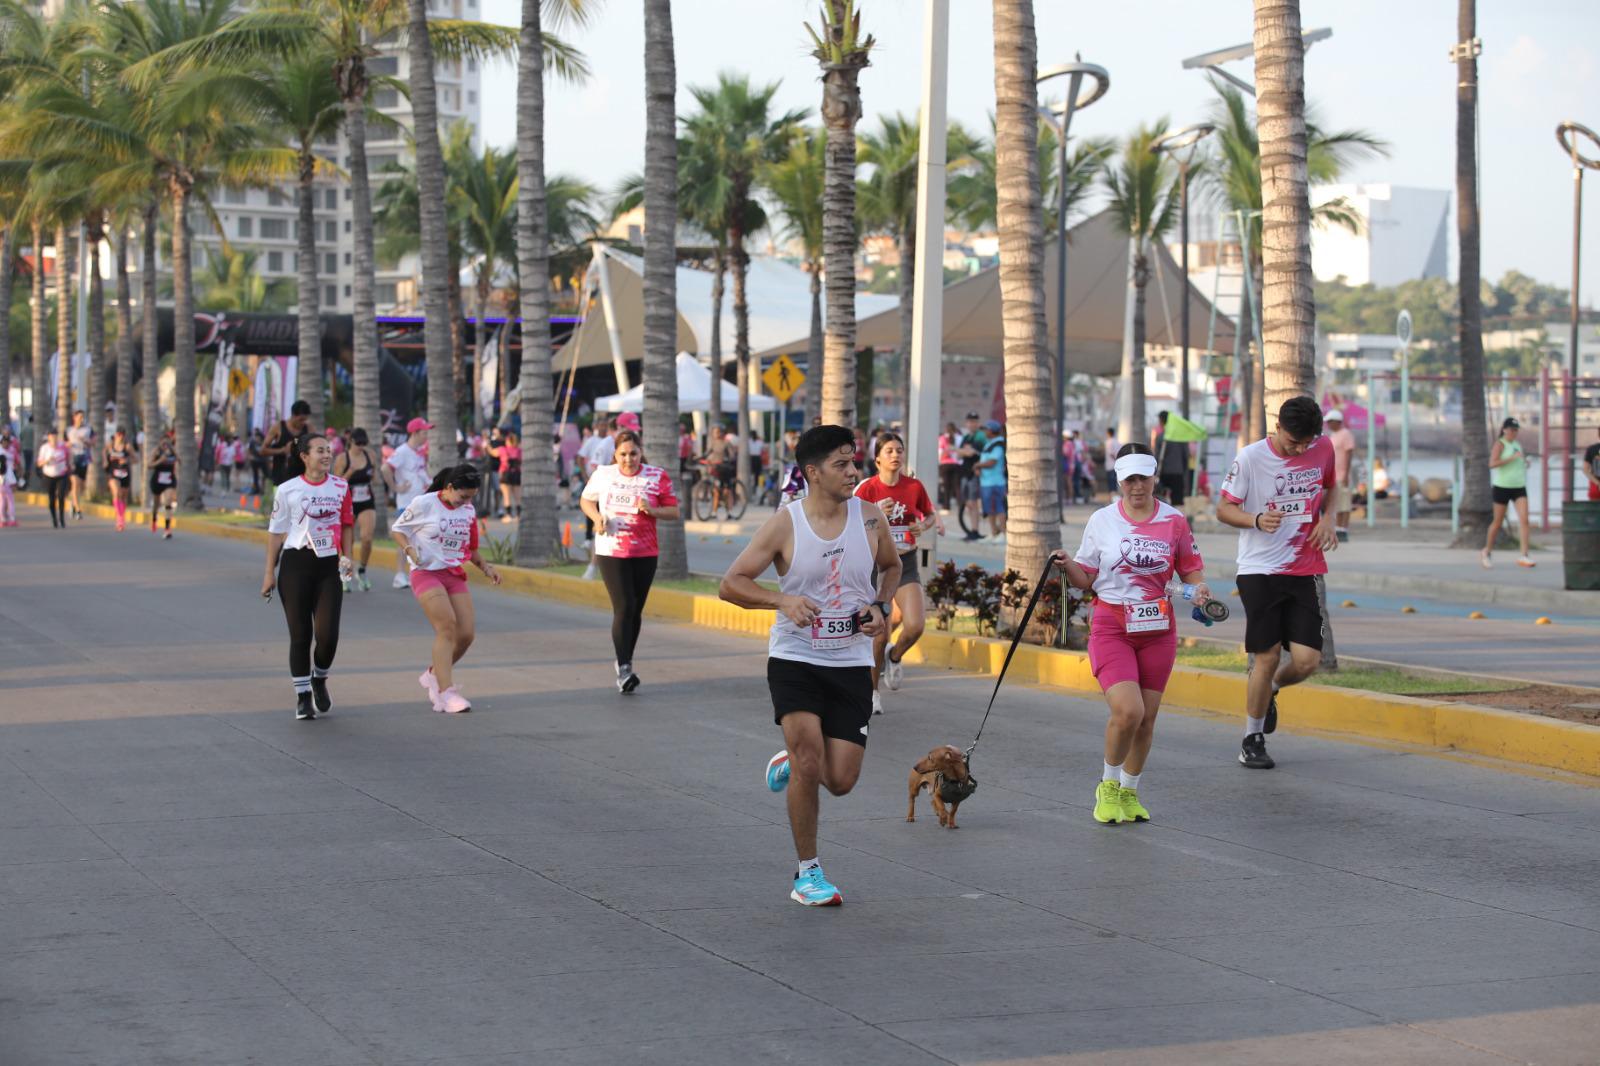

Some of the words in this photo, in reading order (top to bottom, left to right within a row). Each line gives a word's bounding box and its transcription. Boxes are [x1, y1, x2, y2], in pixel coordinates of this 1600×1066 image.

[616, 495, 631, 504] 550
[1281, 503, 1299, 513] 424
[443, 539, 458, 549] 549
[1137, 606, 1160, 618] 269
[827, 620, 852, 634] 539
